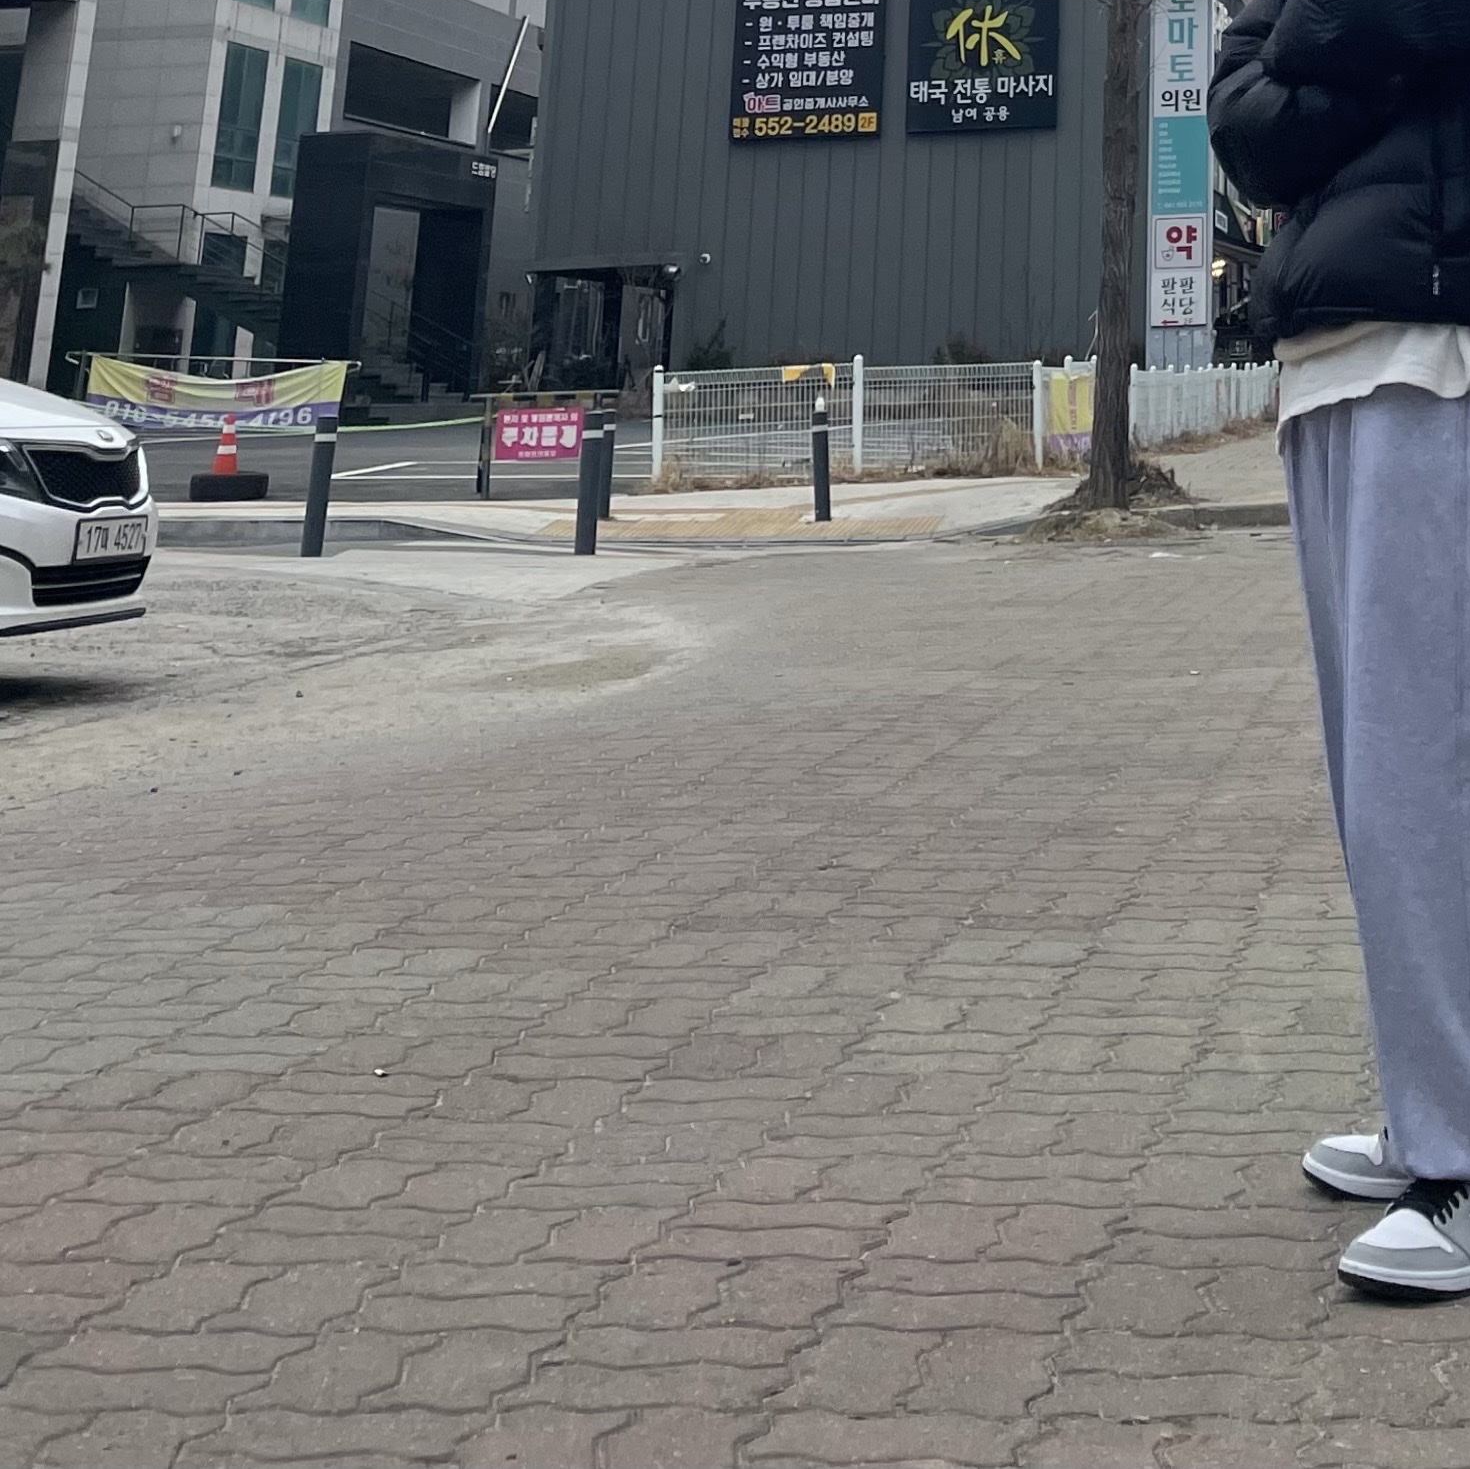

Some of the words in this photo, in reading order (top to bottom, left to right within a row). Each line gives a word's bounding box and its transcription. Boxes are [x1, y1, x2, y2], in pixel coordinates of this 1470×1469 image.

[820, 12, 875, 29] 책임중개
[832, 31, 874, 47] 컨설팅
[946, 5, 1022, 66] 休
[757, 53, 798, 69] 수익형
[804, 51, 846, 67] 부동산
[756, 72, 783, 89] 상가
[909, 81, 948, 105] 태국
[953, 78, 992, 104] 전통
[997, 74, 1053, 98] 마사지
[782, 96, 869, 111] 공인중개사사무소
[1161, 89, 1201, 112] 의원
[951, 107, 978, 123] 남여
[983, 106, 1010, 122] 공용
[754, 114, 856, 136] 552-2489
[1166, 225, 1198, 260] 약
[1161, 297, 1194, 315] 식당
[113, 522, 142, 551] 4527
